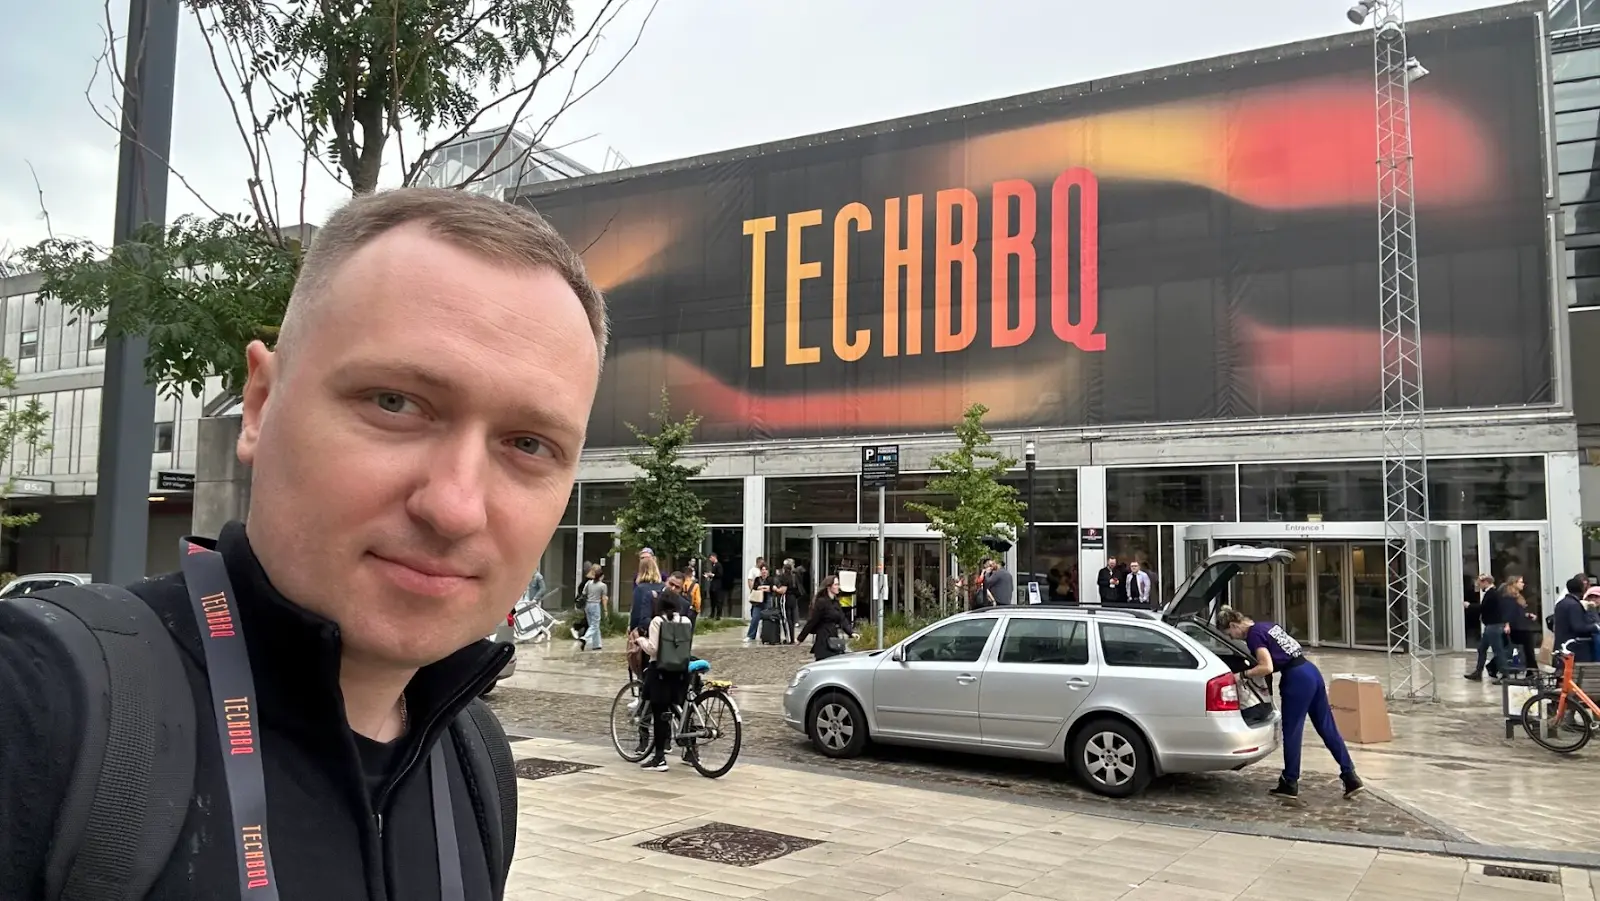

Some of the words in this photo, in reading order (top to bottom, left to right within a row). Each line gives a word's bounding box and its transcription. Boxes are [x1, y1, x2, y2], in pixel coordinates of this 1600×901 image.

[743, 166, 1107, 368] TECHBBQ
[866, 449, 874, 460] P
[1285, 523, 1320, 531] Entrance
[1321, 523, 1325, 531] 1
[200, 591, 236, 638] TECHBBQ
[223, 696, 254, 756] TECHBBQ
[242, 824, 269, 890] TECHBBQ
